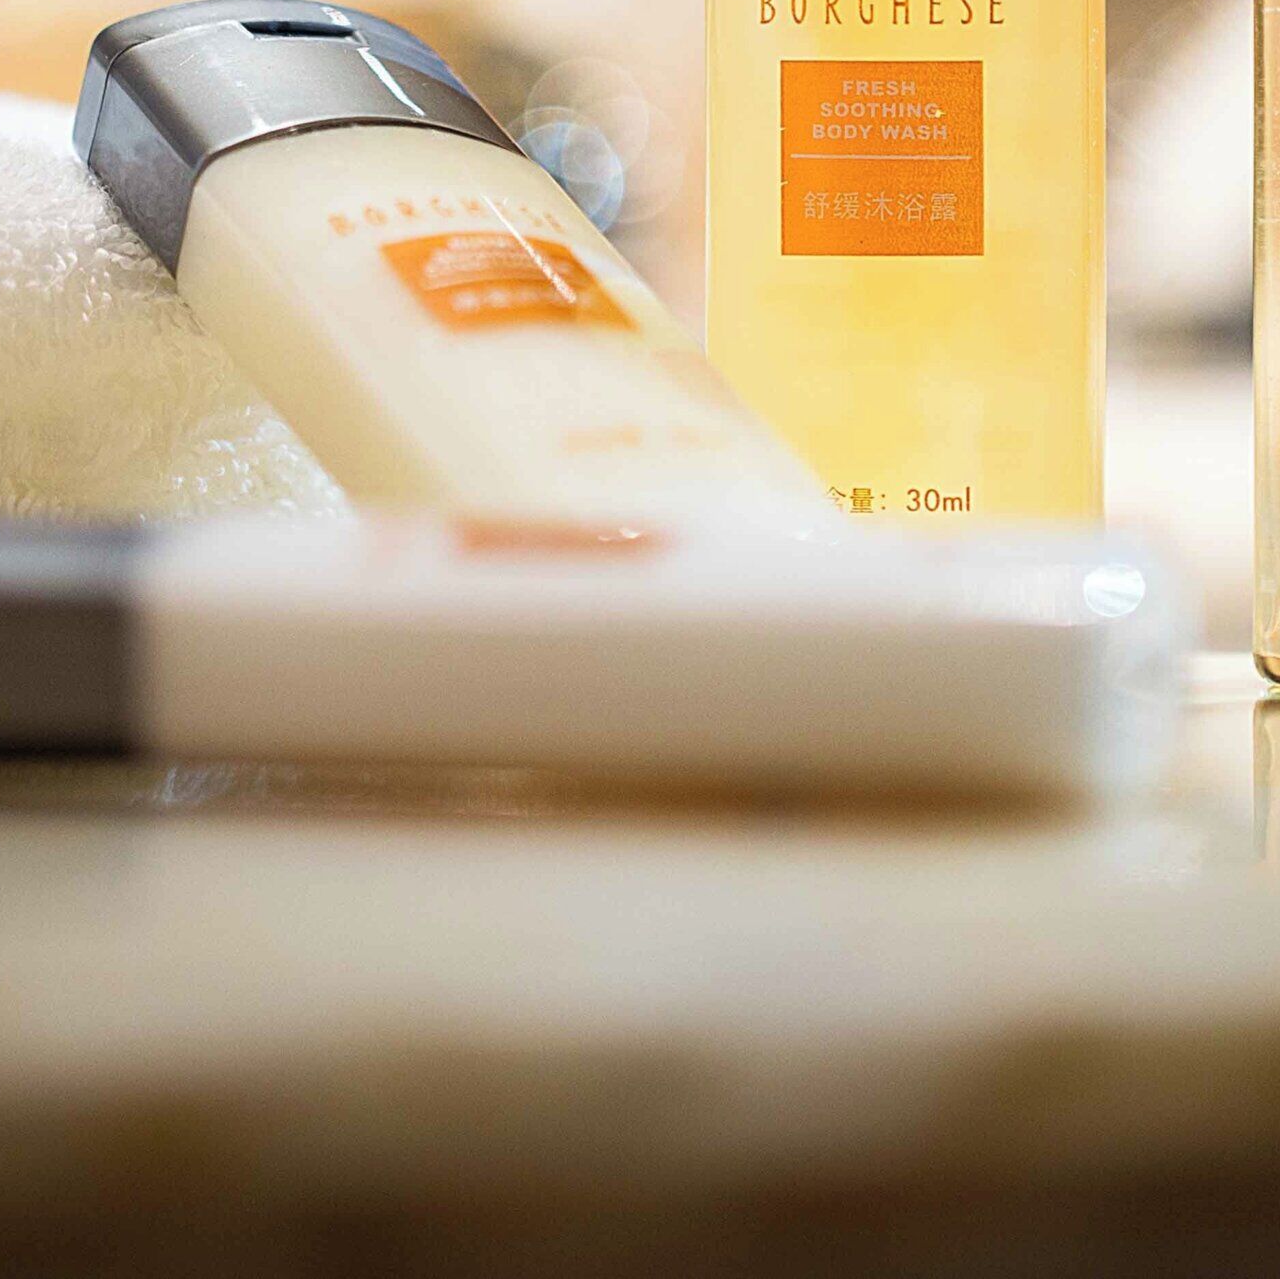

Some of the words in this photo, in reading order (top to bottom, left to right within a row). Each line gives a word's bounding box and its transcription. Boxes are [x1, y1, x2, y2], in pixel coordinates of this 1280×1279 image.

[842, 80, 917, 96] FRESH
[819, 102, 942, 118] SOOTHING
[811, 124, 873, 140] BODY
[880, 124, 948, 141] WASH
[801, 191, 958, 222] 舒缓沐浴露
[905, 485, 972, 513] 30ml
